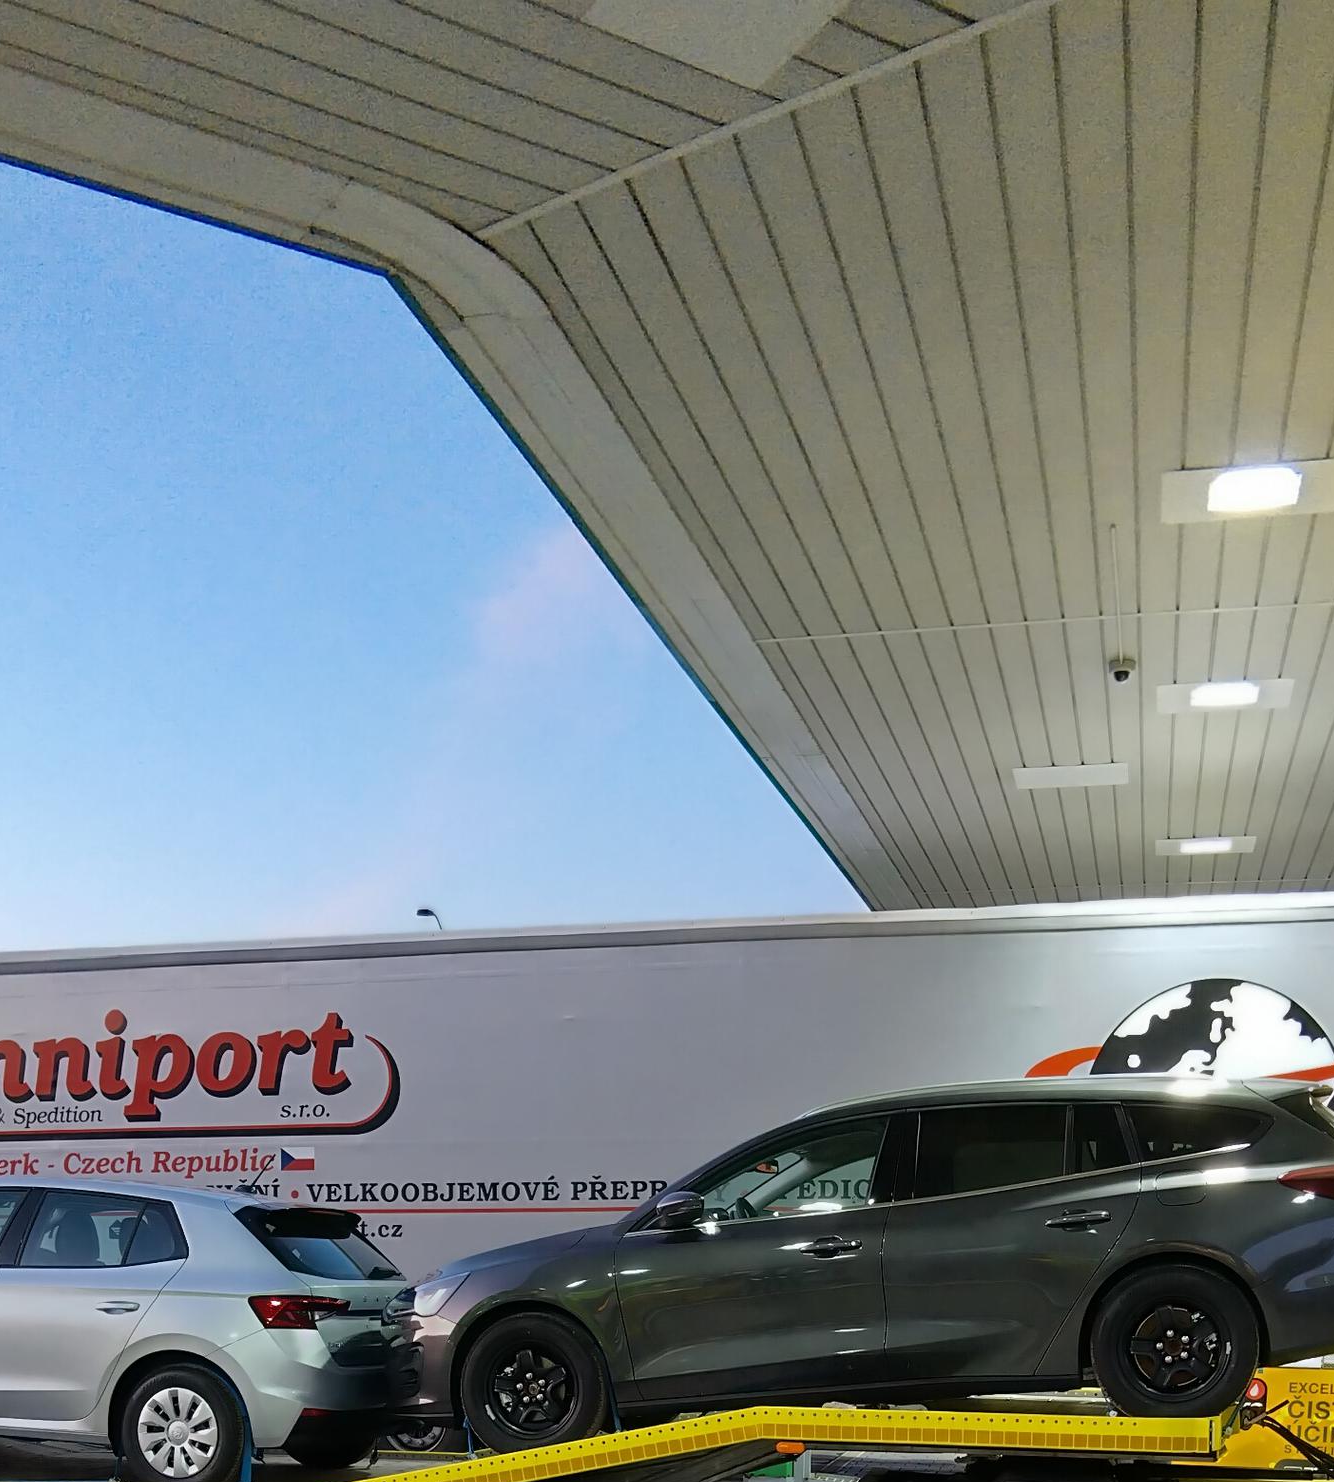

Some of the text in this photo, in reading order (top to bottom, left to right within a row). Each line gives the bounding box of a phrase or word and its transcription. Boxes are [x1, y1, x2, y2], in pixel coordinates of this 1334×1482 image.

[13, 1105, 103, 1128] Spedition
[279, 1103, 331, 1118] s.r.o.
[63, 1150, 143, 1174] Czech
[151, 1147, 277, 1179] Republic
[306, 1174, 561, 1204] VELKOOBJEMOVÉ
[359, 1220, 403, 1238] t.cz
